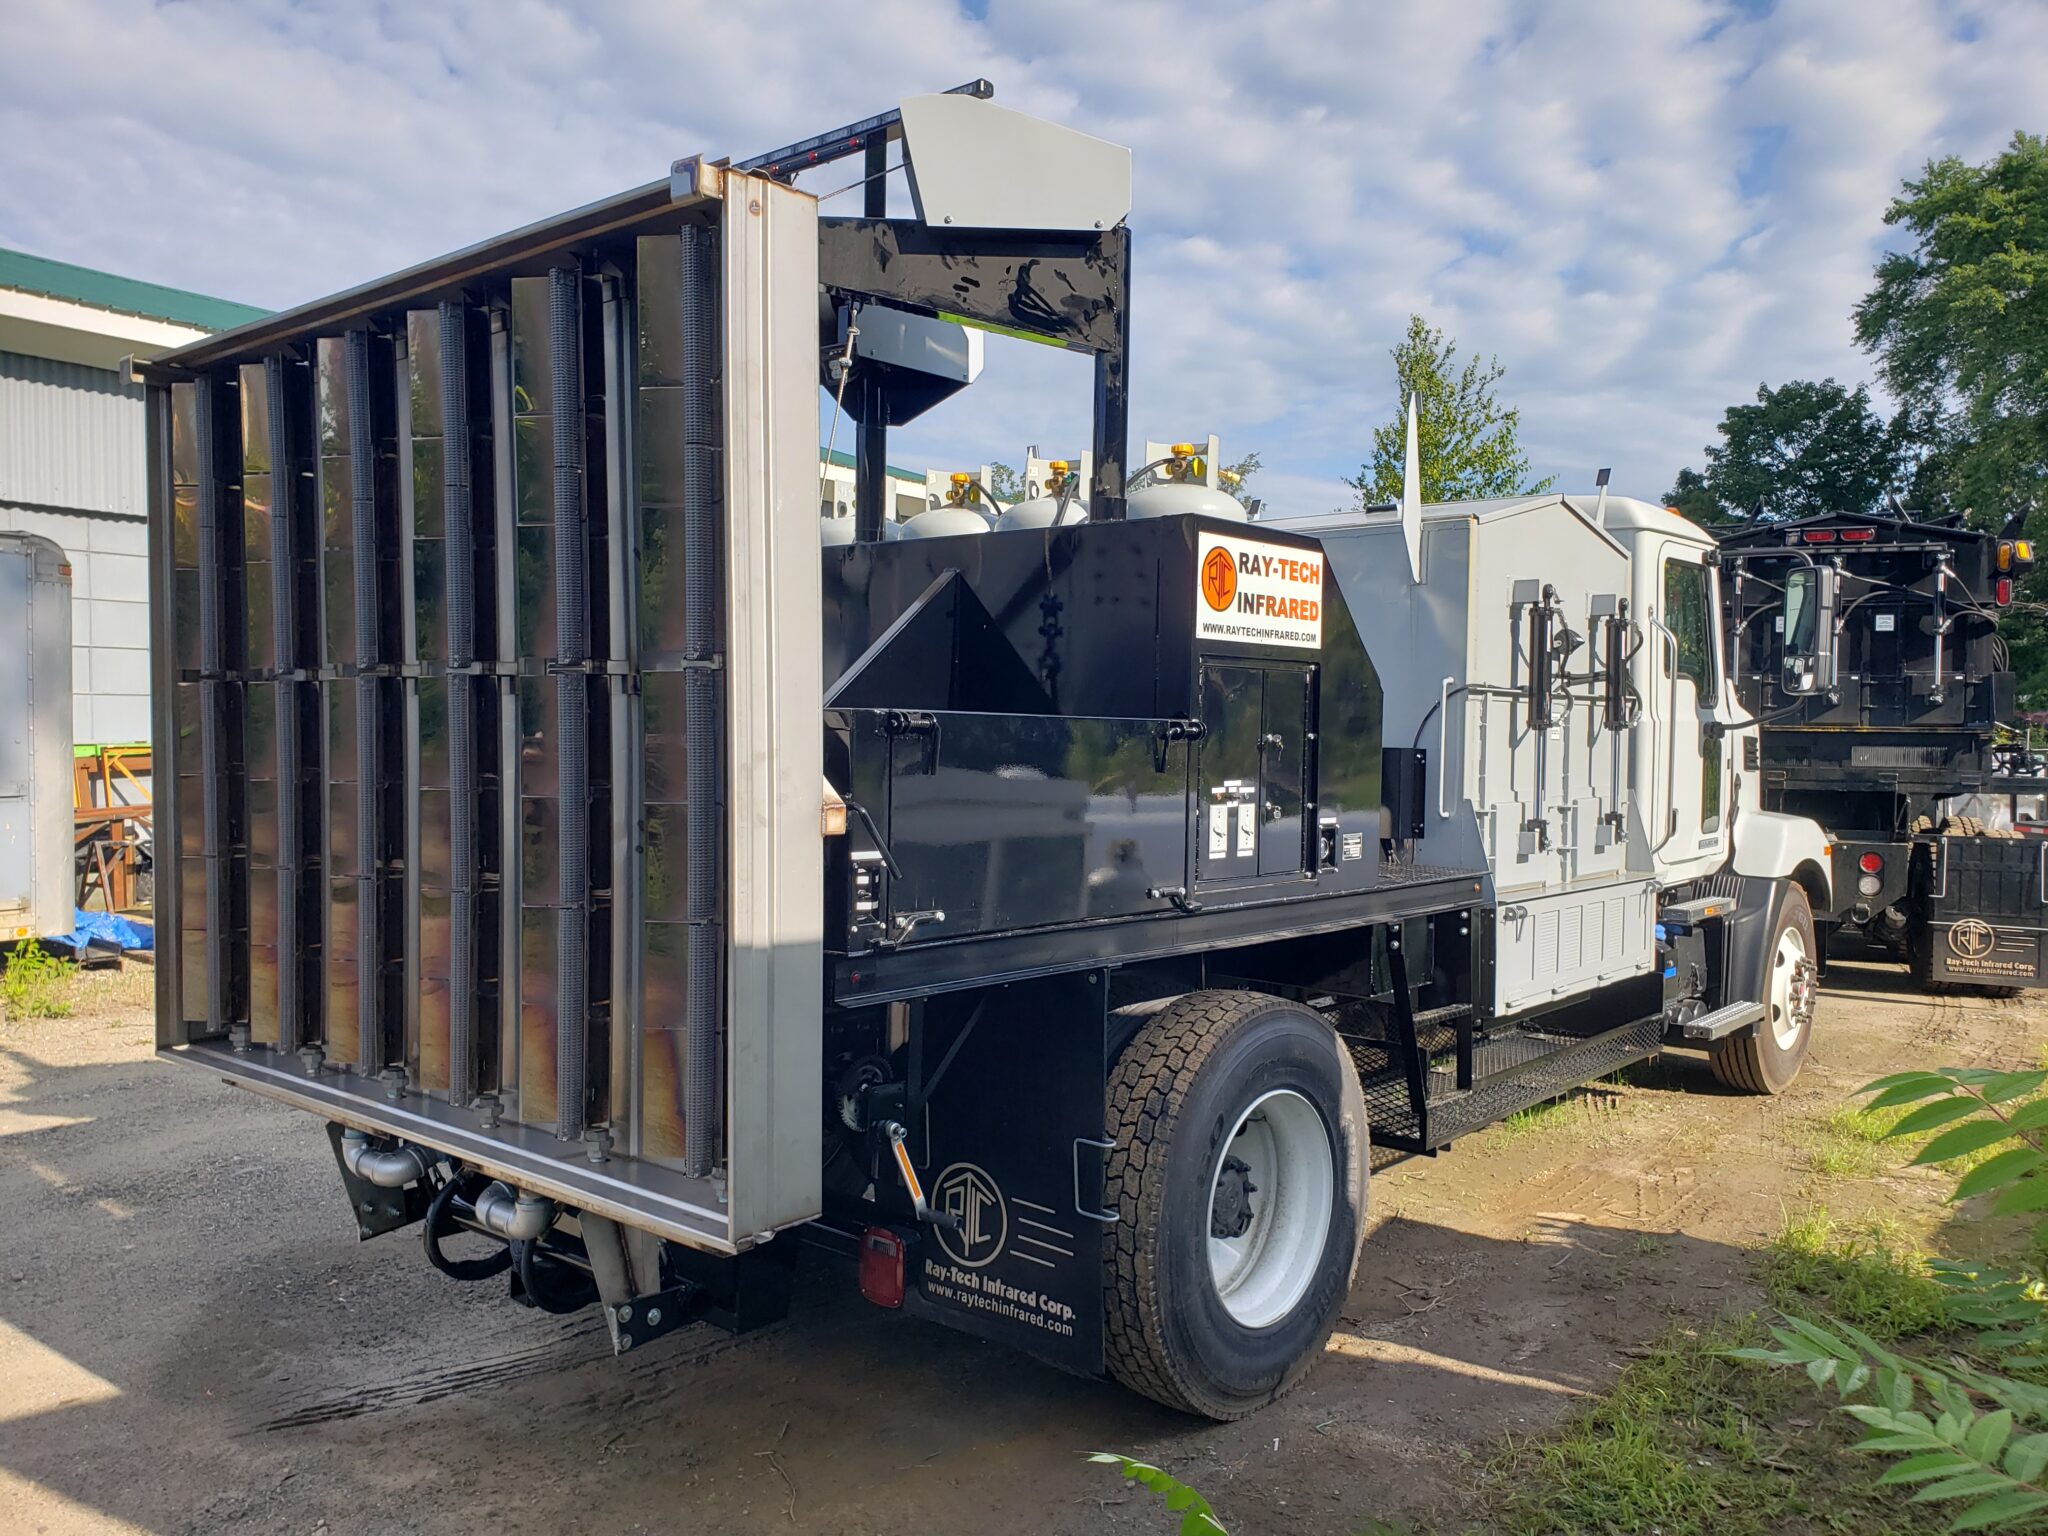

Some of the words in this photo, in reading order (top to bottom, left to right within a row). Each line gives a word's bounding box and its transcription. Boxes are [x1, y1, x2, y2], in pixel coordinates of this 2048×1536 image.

[1238, 552, 1320, 585] RAY-TECH
[1237, 592, 1319, 621] INFRARED
[1202, 622, 1317, 642] WWW.RAYTECHINFRARED.COM
[1946, 957, 1980, 967] Ray-Tech
[1981, 959, 2013, 969] Infrared
[2014, 962, 2036, 971] Corp.
[1948, 966, 2034, 977] www.raytechinfrared.com
[925, 1258, 980, 1290] Ray-Tech
[982, 1275, 1037, 1308] Infrared
[1038, 1294, 1077, 1321] Corp.
[927, 1280, 1073, 1337] www.raytechinfrared.com
